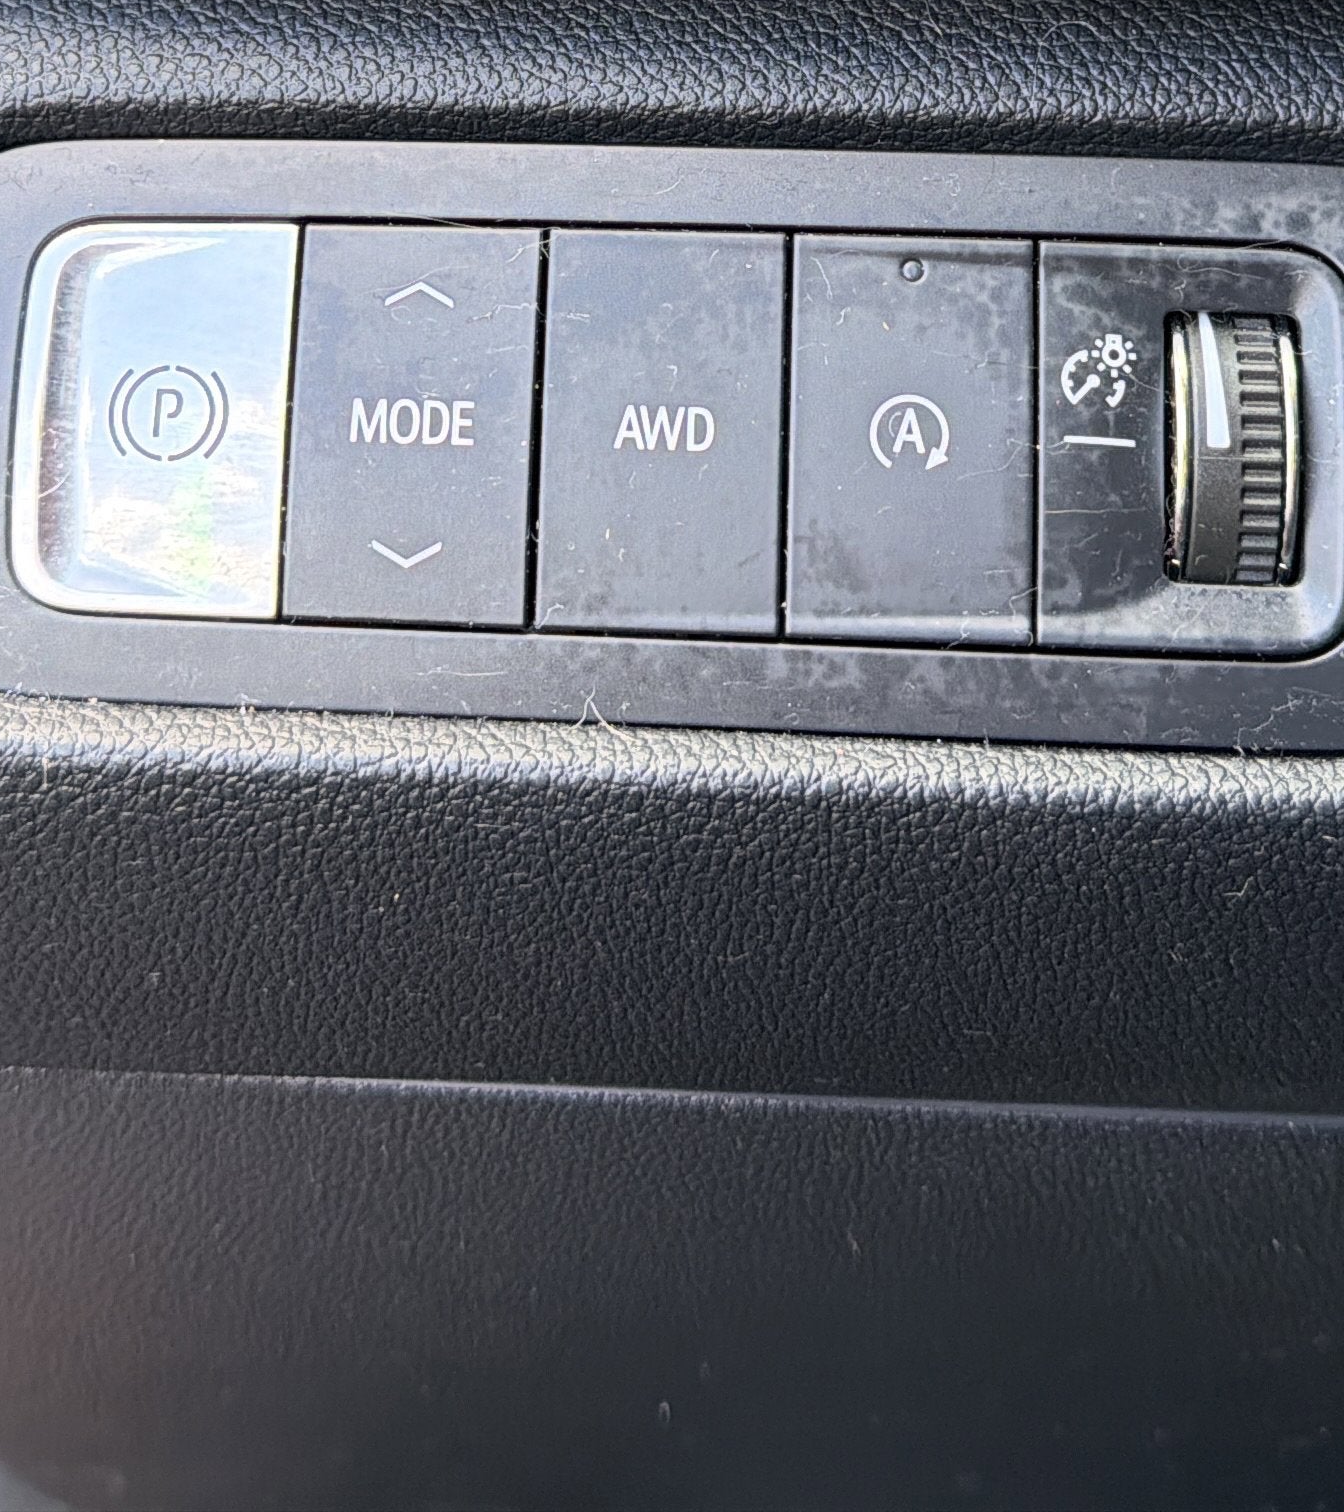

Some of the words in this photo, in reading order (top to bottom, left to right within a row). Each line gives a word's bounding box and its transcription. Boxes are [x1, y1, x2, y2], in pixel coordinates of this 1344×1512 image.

[152, 388, 184, 437] P
[349, 397, 475, 446] MODE
[613, 404, 715, 451] AWD
[892, 407, 926, 454] A
